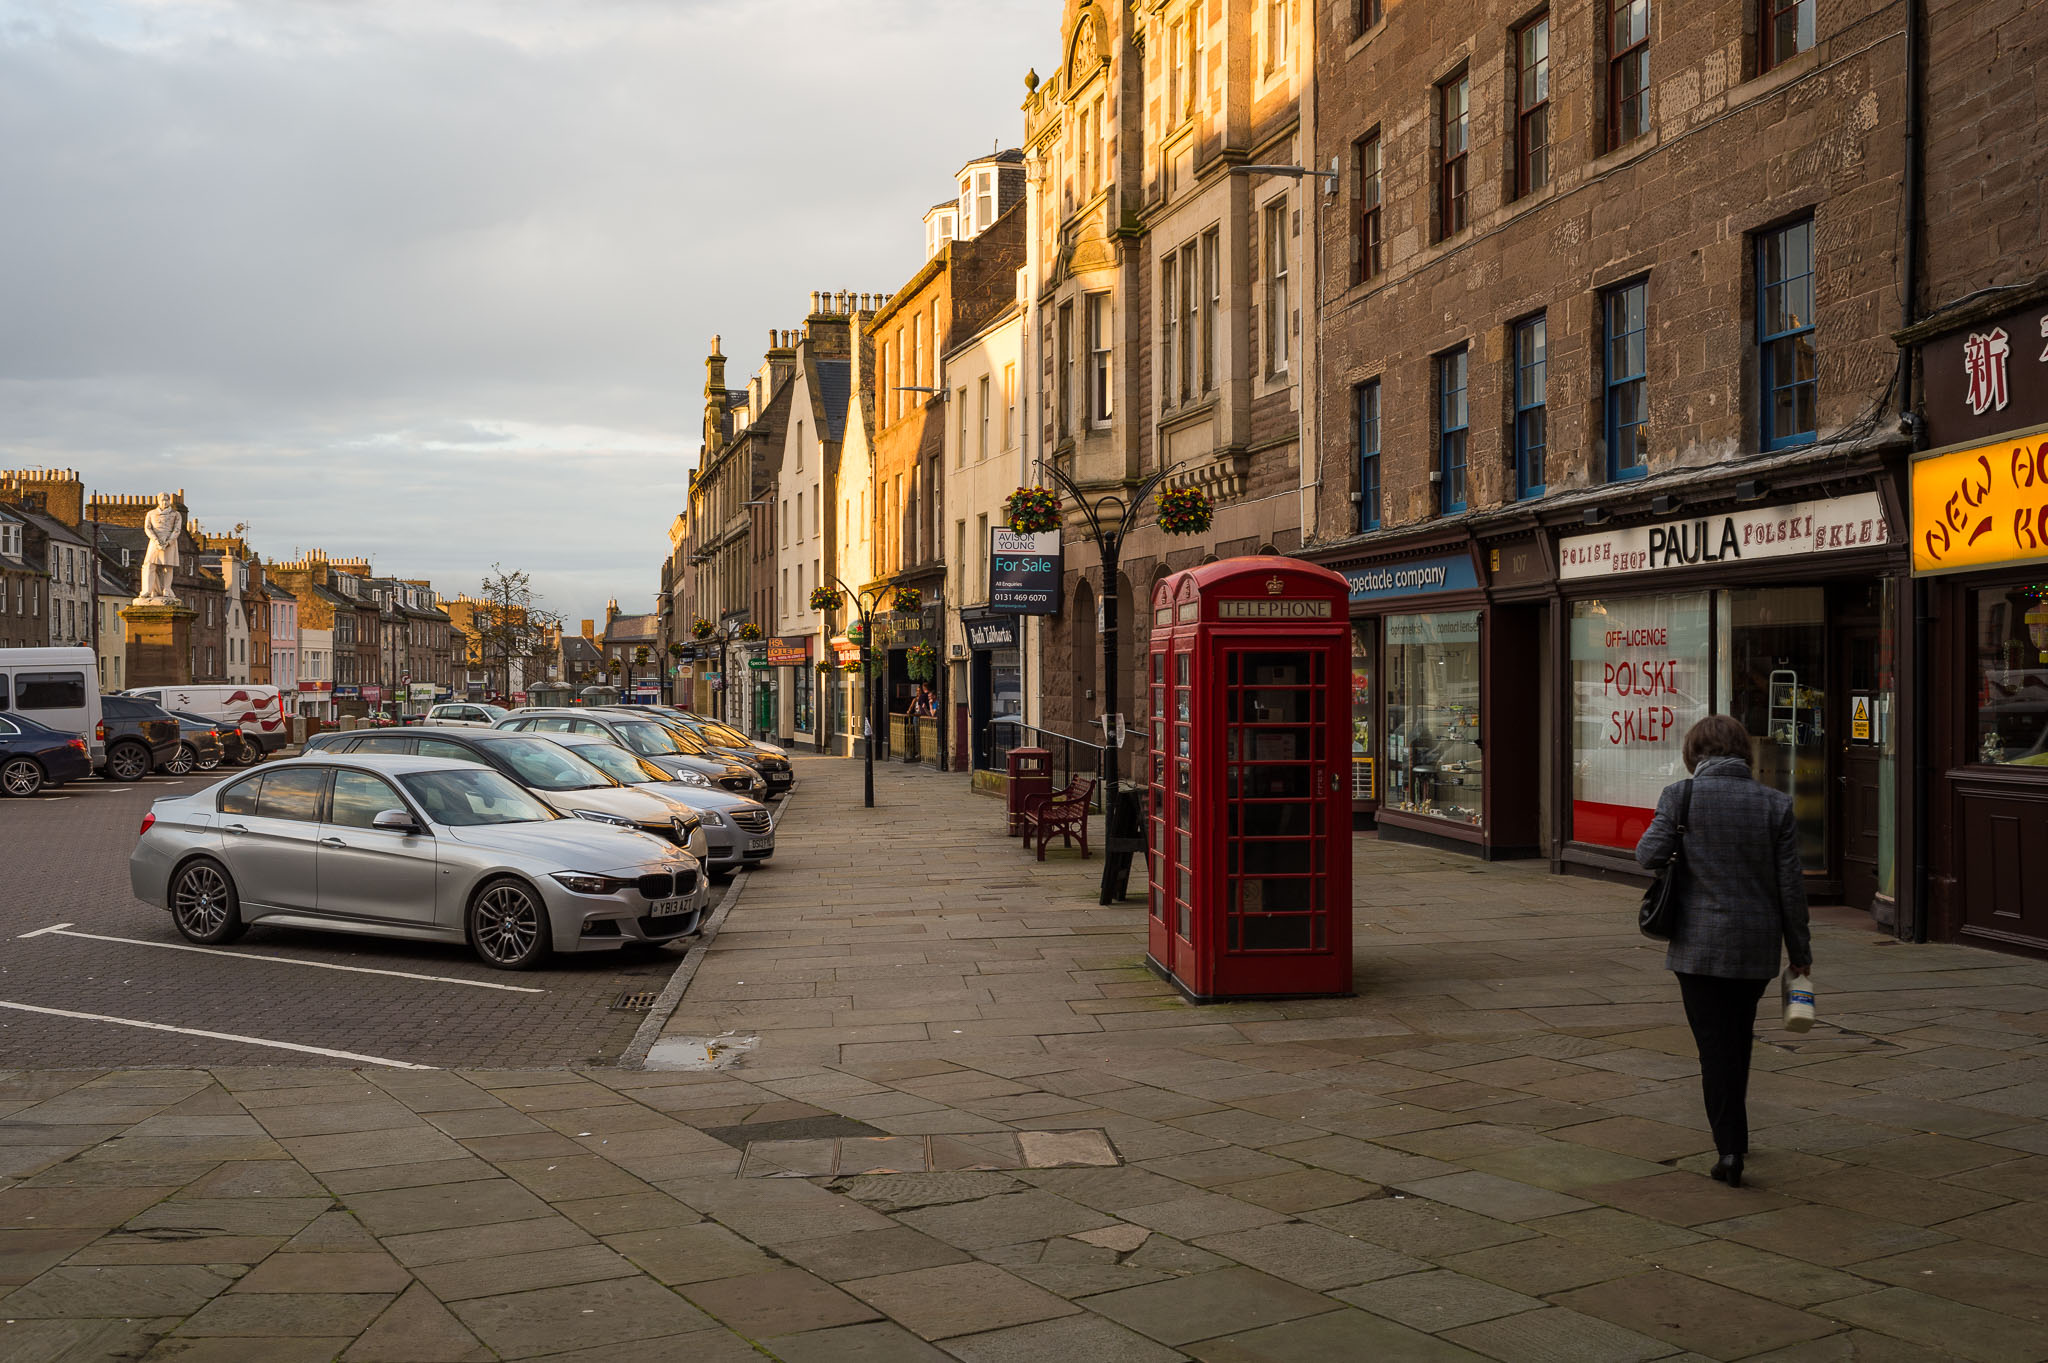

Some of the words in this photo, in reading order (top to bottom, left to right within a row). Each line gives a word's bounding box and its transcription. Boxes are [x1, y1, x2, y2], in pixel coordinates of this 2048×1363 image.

[1926, 455, 1992, 561] NEW
[999, 532, 1035, 542] AVISON
[999, 541, 1035, 550] YOUNG
[1562, 542, 1611, 566] POLISH
[1613, 551, 1646, 571] SHOP
[1649, 517, 1740, 568] PAULA
[1743, 514, 1812, 546] POLSKI
[995, 557, 1019, 572] For
[1021, 558, 1052, 573] Sale
[1513, 554, 1527, 574] 107
[1348, 569, 1393, 596] spectacle
[1395, 566, 1446, 589] company
[1014, 594, 1028, 602] 469
[1029, 594, 1047, 602] 6070
[1223, 602, 1327, 617] TELEPHONE
[1391, 623, 1424, 636] optometrist
[1437, 621, 1459, 633] contact
[1605, 628, 1667, 647] OFF-LICENCE
[1604, 660, 1677, 696] POLSKI
[1610, 706, 1674, 745] SKLEP
